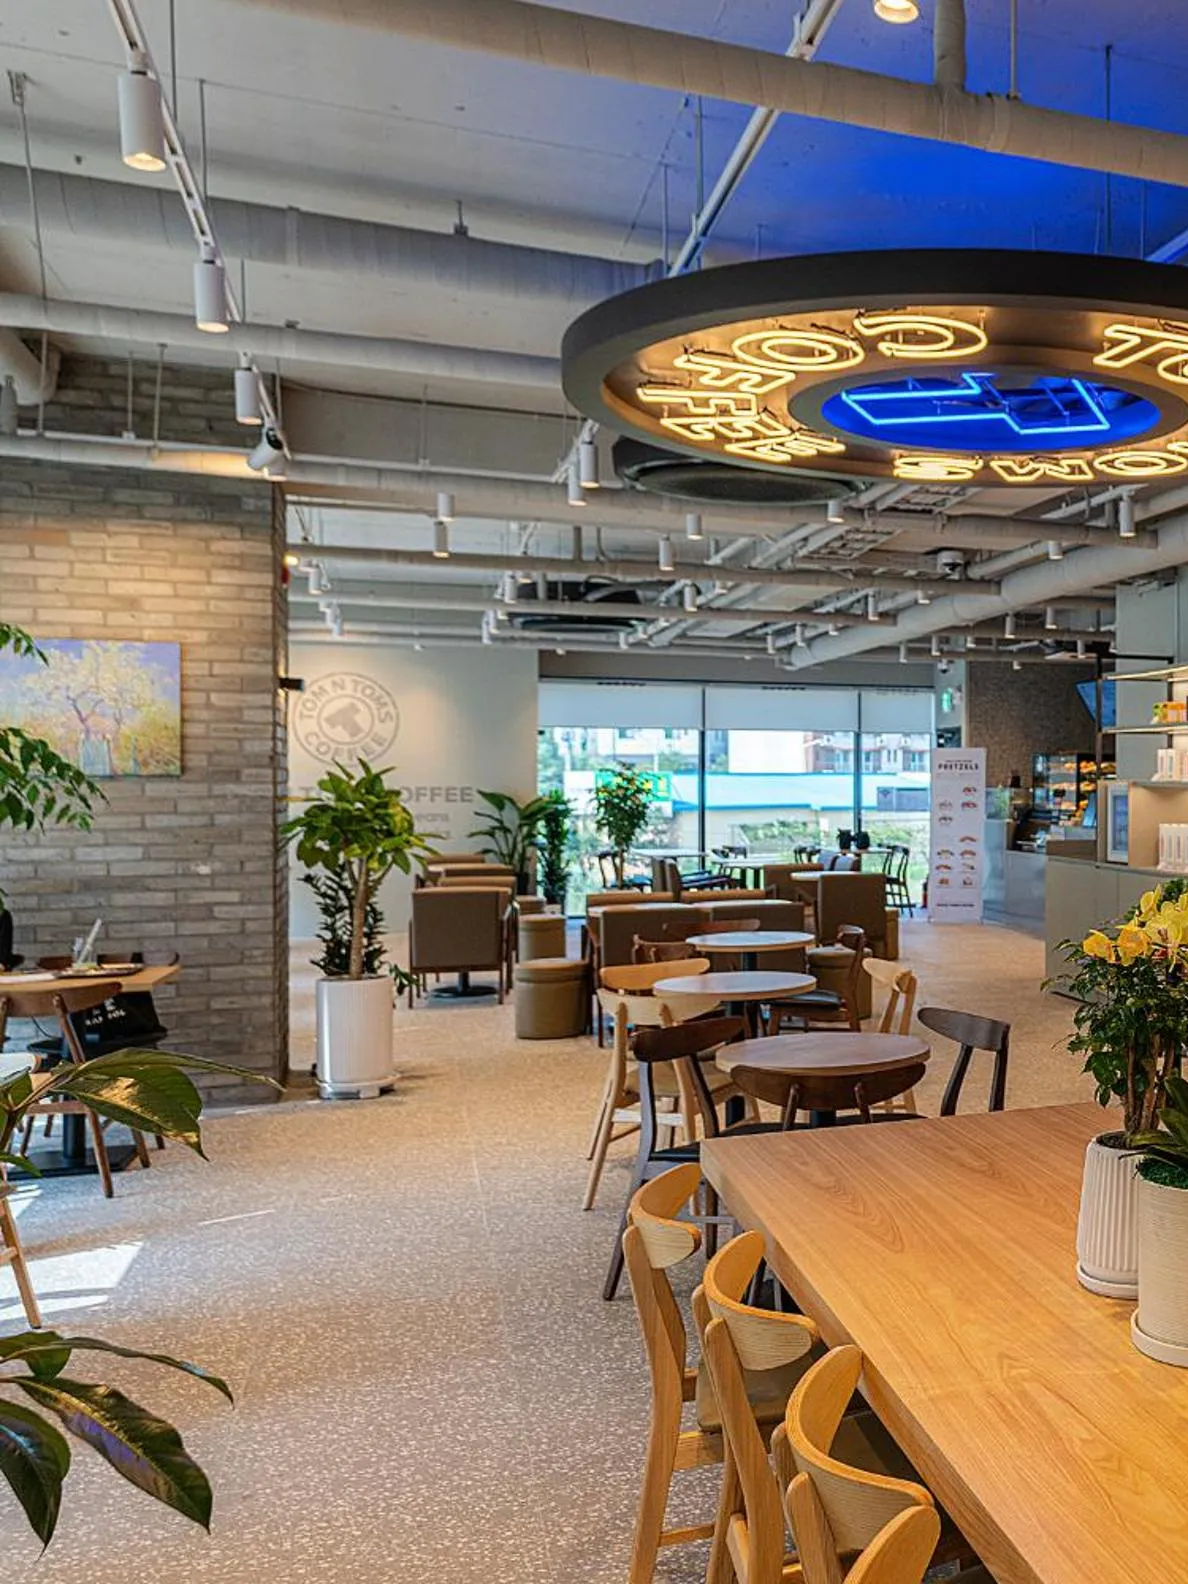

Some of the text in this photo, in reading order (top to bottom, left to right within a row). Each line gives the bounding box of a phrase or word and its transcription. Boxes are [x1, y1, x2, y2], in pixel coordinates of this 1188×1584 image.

[636, 314, 989, 464] COFFEE
[300, 677, 395, 726] TOM N TOMS
[303, 731, 389, 764] COFFEE
[400, 785, 474, 803] OFFEE
